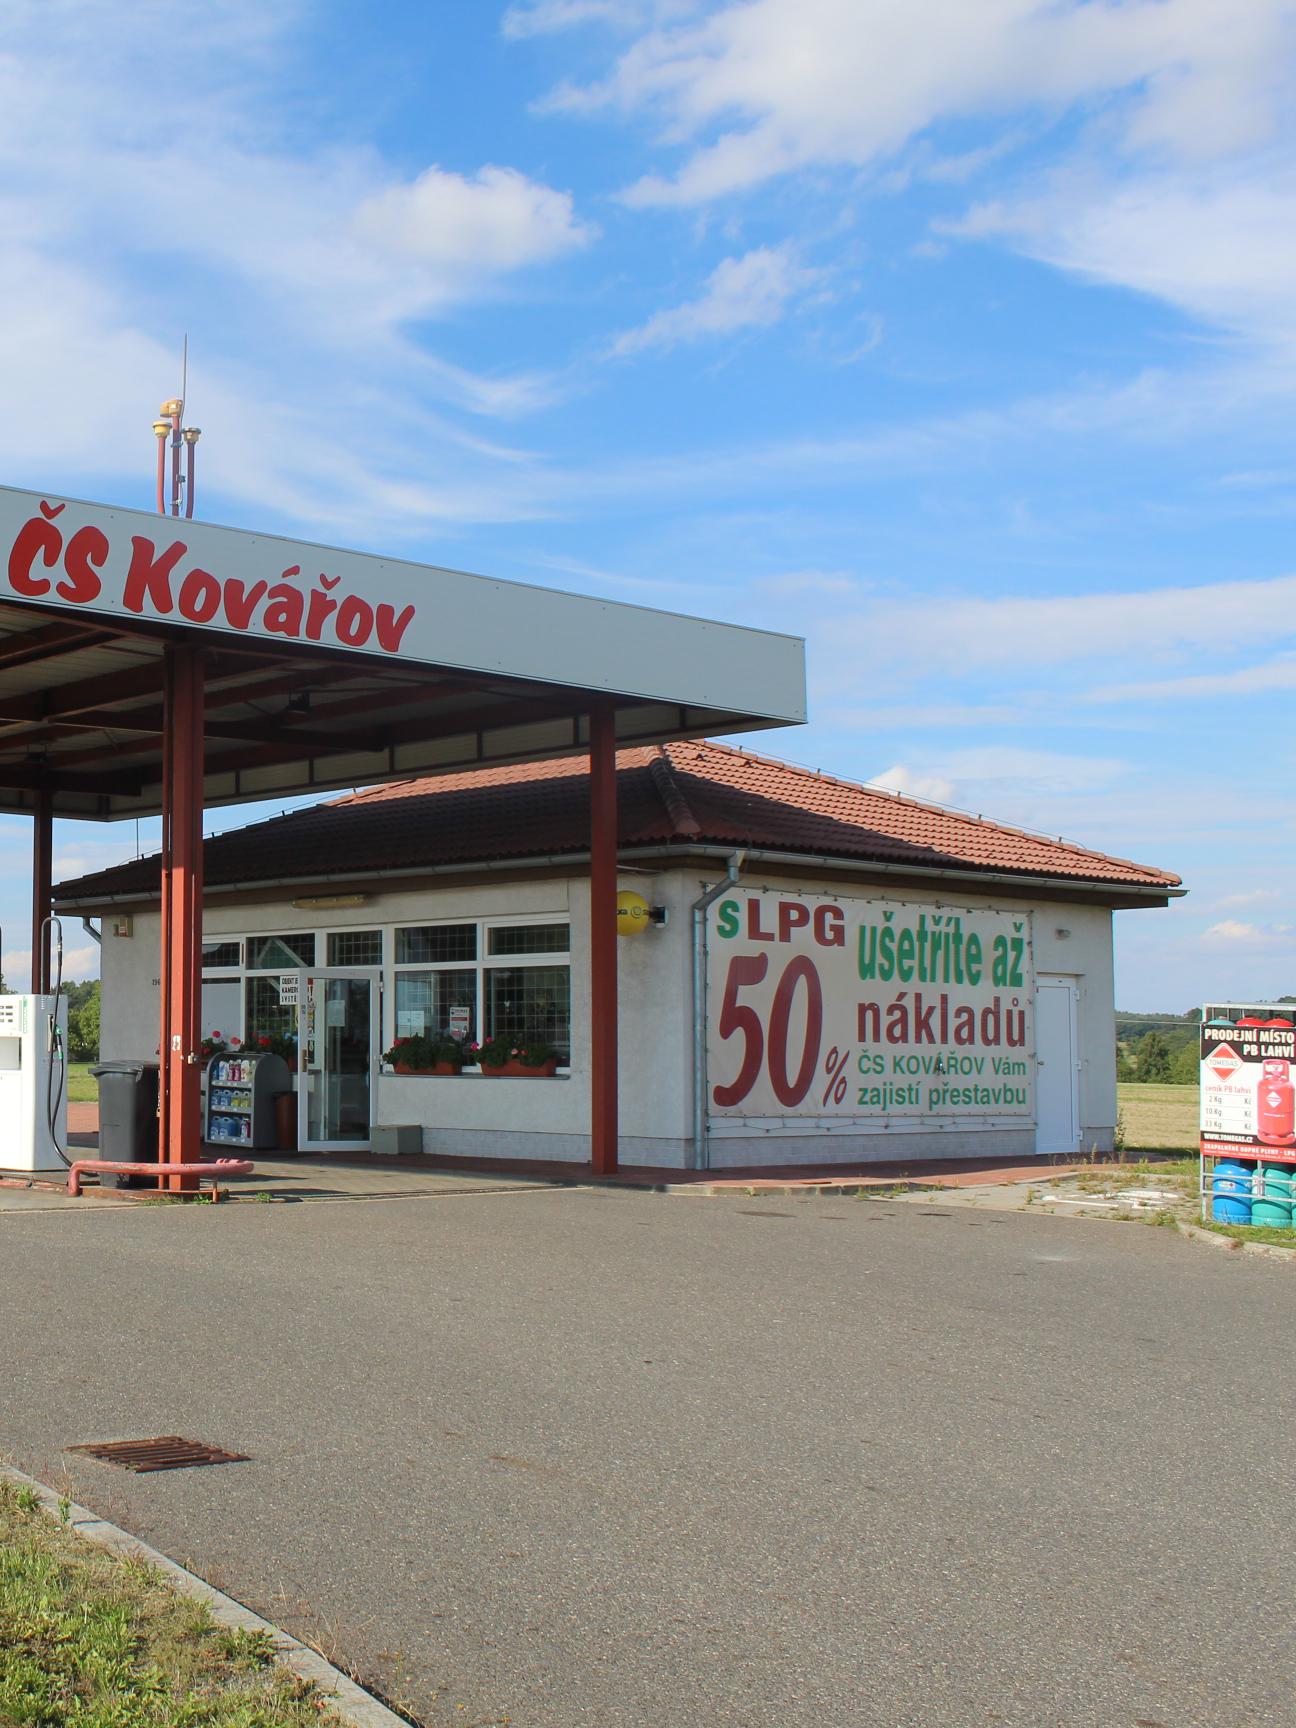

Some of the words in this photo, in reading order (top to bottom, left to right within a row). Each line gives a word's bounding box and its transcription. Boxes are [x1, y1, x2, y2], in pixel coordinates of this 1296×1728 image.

[8, 500, 109, 603] ČS
[123, 536, 415, 652] Kovářov
[747, 898, 846, 947] LPG
[858, 911, 983, 986] ušetříte
[993, 922, 1025, 988] až
[857, 992, 1026, 1047] nákladů
[1204, 1028, 1258, 1042] PRODEJNÍ
[1259, 1029, 1295, 1044] MÍSTO
[858, 1050, 885, 1075] ČS
[893, 1051, 984, 1076] KOVÁŘOV
[992, 1056, 1027, 1076] Vám
[1243, 1044, 1259, 1056] PB
[1260, 1044, 1295, 1058] LAHVÍ
[857, 1081, 922, 1111] zajistí
[929, 1082, 1027, 1111] přestavbu
